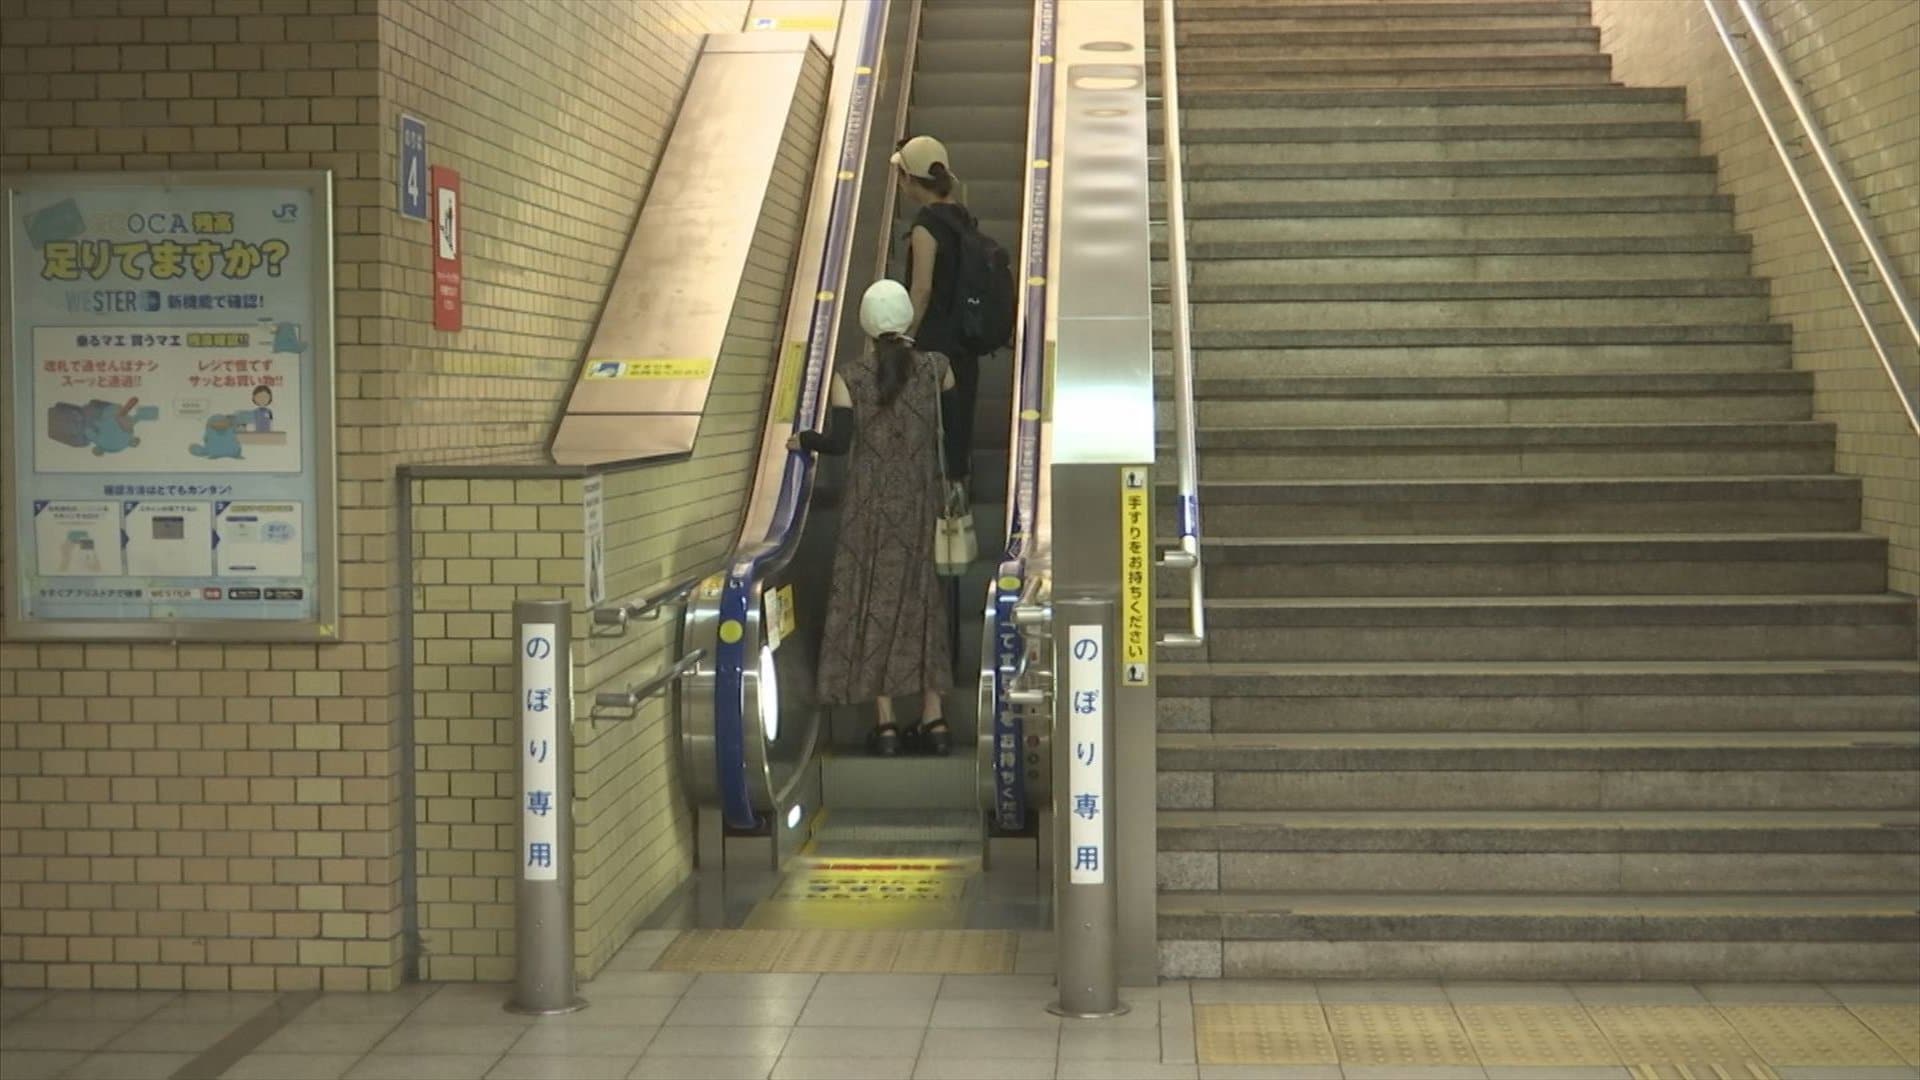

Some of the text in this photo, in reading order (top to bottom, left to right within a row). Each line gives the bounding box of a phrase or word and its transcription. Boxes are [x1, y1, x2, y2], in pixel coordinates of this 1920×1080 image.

[271, 203, 298, 218] JR
[407, 156, 419, 207] 4
[41, 239, 290, 280] 足りてますか?
[1128, 495, 1143, 658] 手すりをお持ちください
[526, 636, 552, 868] のぼり専用
[1074, 638, 1099, 871] のぼり専用
